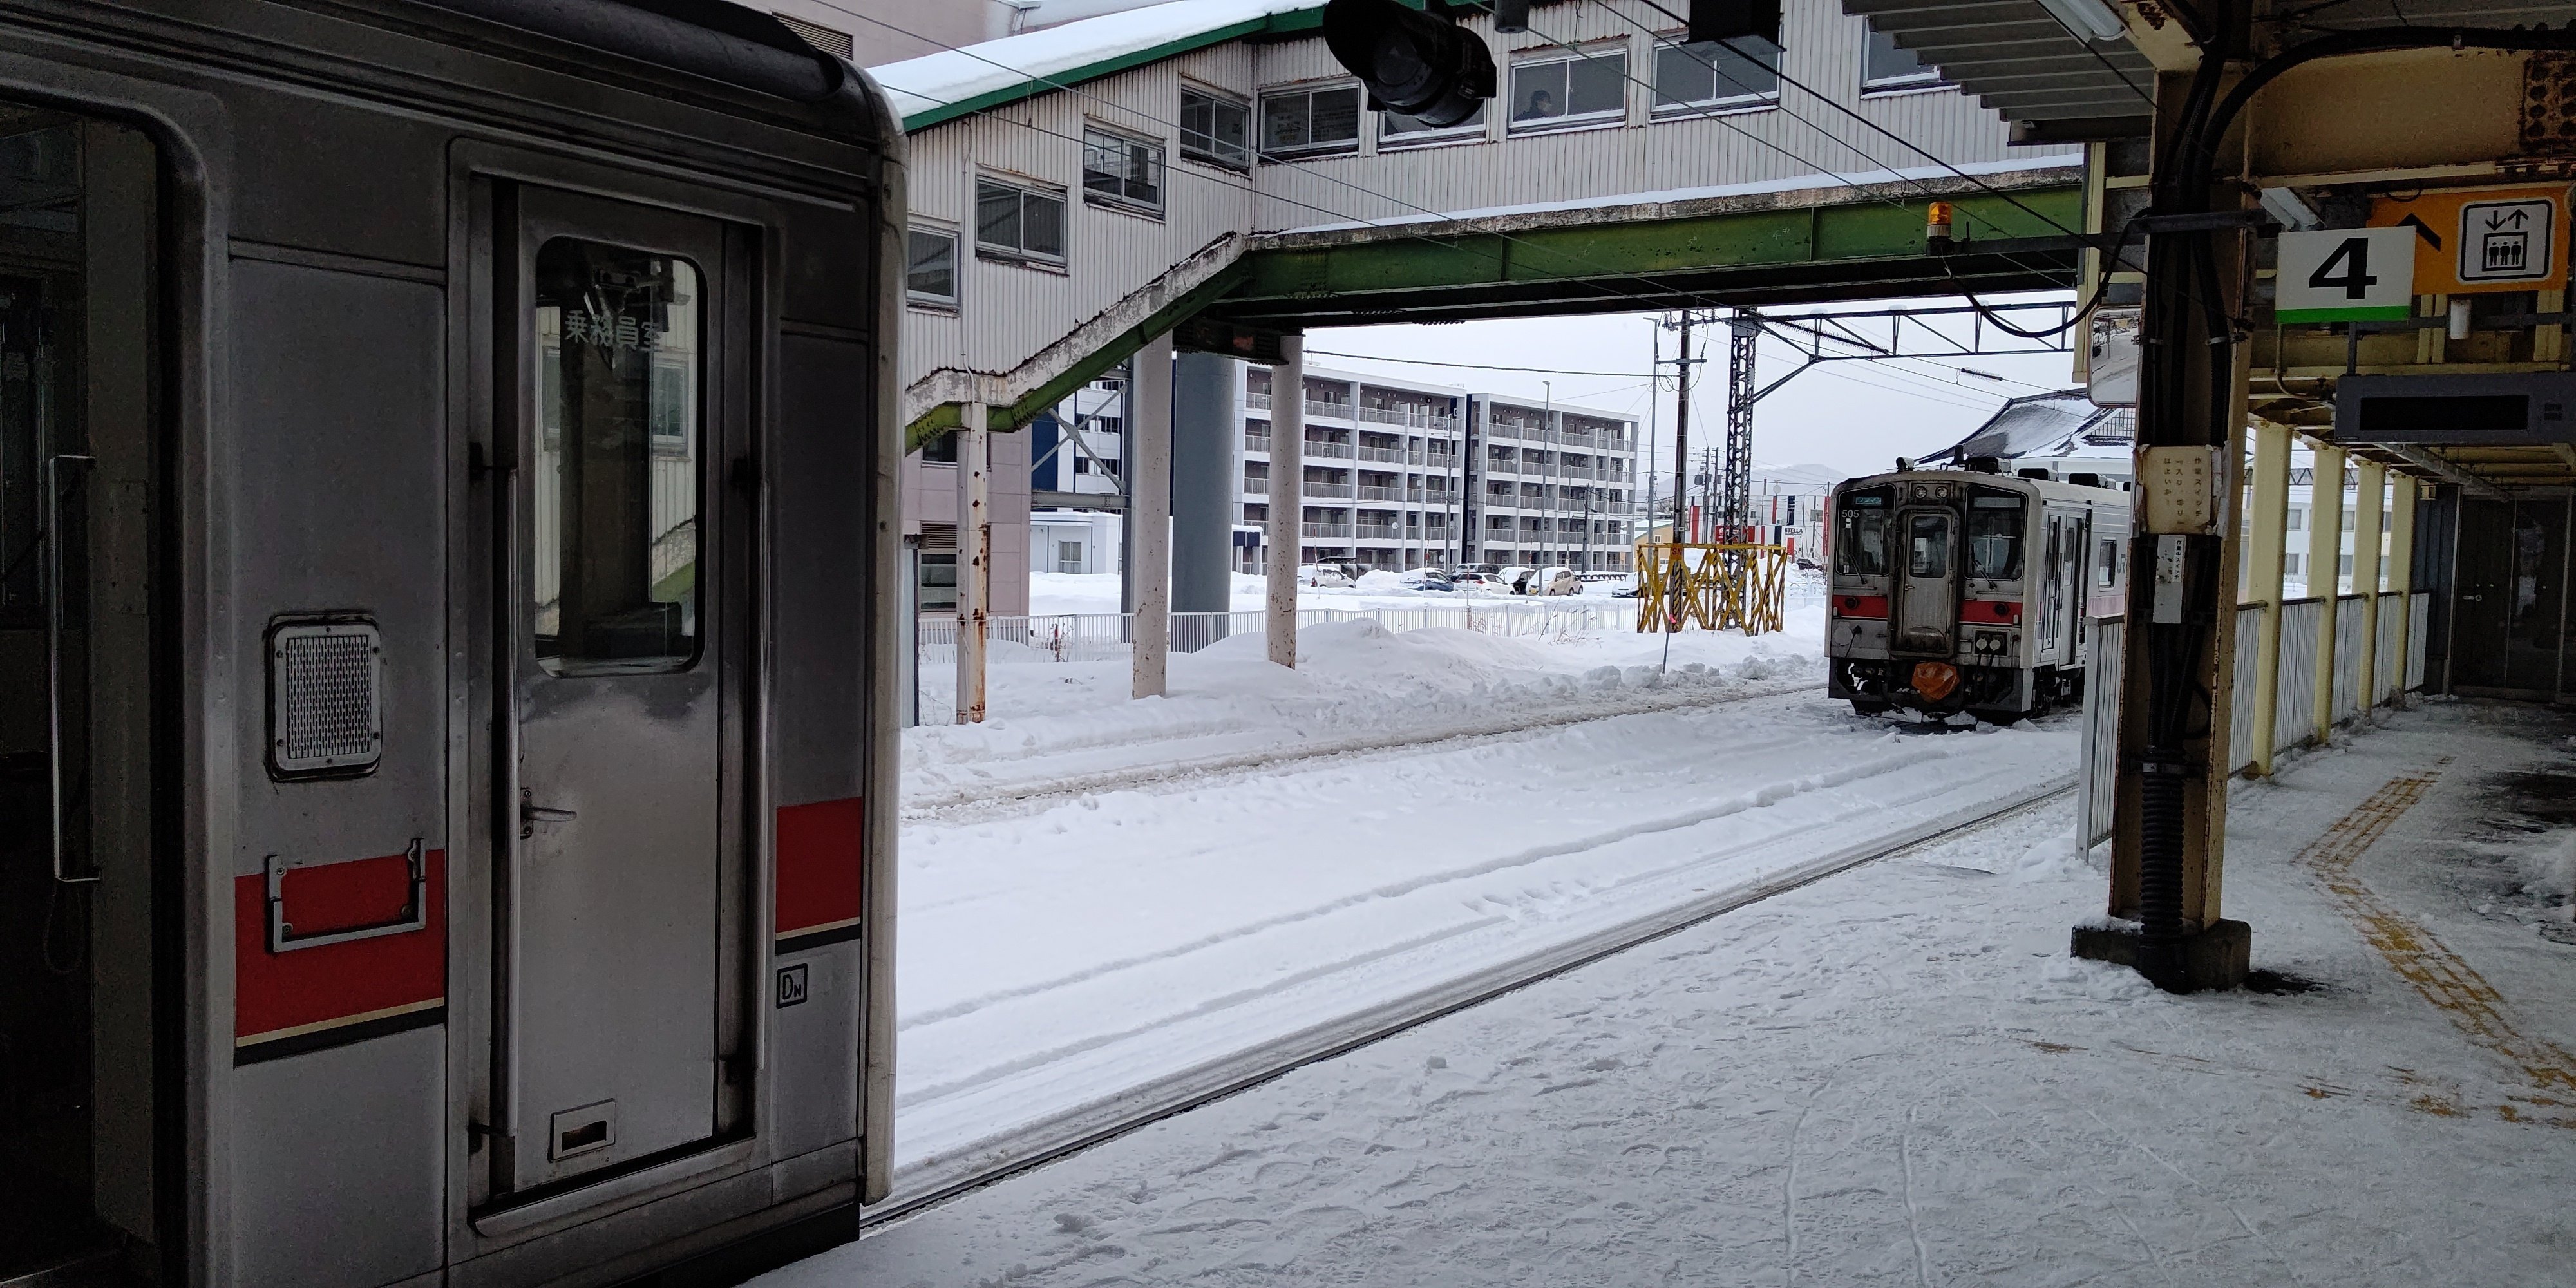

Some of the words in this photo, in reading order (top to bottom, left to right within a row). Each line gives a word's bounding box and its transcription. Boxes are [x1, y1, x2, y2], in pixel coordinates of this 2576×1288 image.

[2309, 237, 2377, 300] 4
[564, 310, 662, 352] 乗務員室
[1842, 509, 1859, 518] 505
